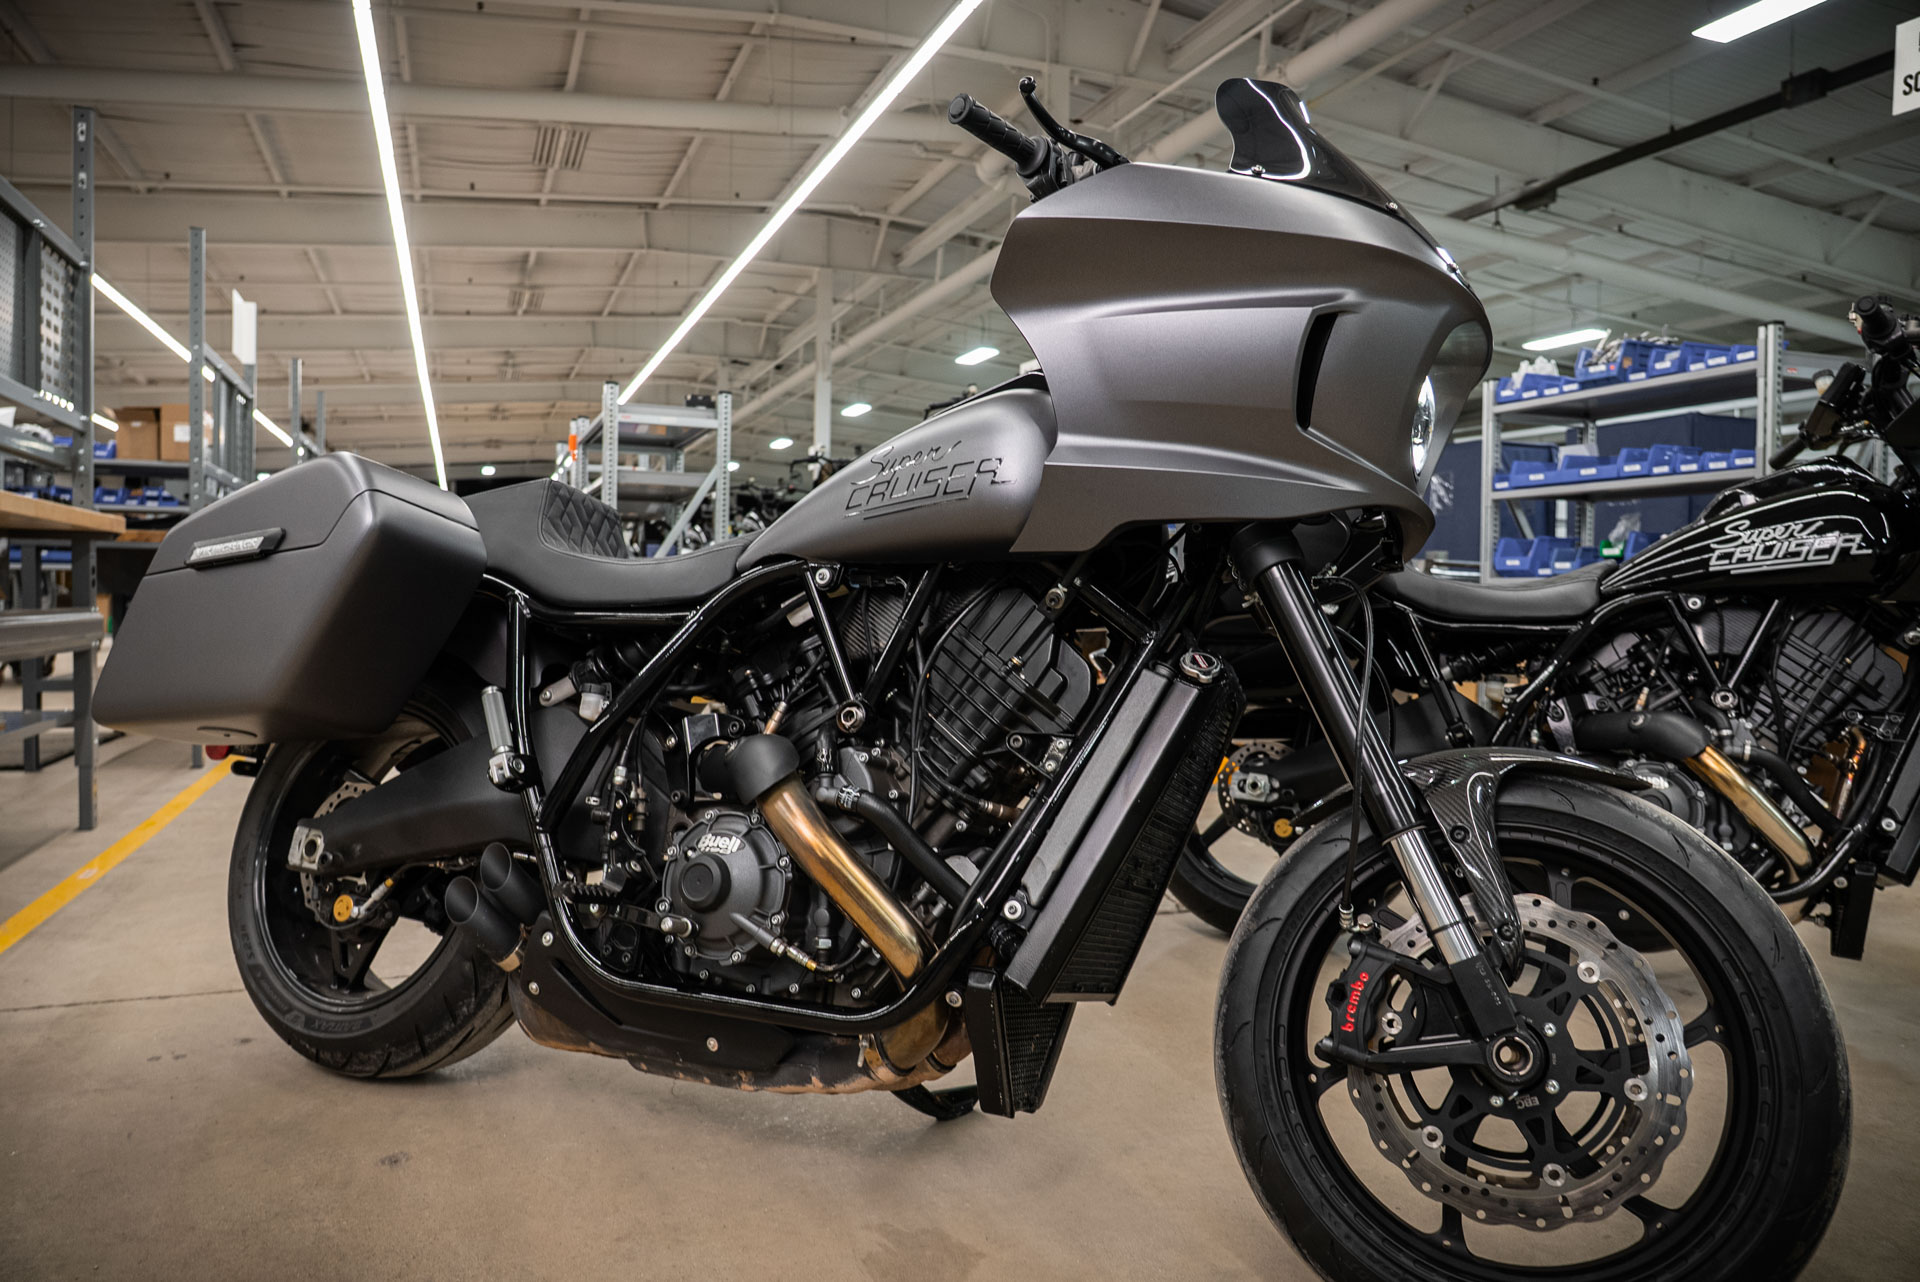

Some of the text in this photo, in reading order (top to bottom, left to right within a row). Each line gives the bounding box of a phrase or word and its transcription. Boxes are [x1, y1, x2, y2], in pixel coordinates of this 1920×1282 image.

[851, 440, 962, 485] Super
[845, 457, 1017, 512] CRUISER
[1709, 531, 1873, 567] CRUISER
[1710, 519, 1824, 549] Super
[698, 833, 741, 853] Buell
[1340, 971, 1369, 1032] brembo
[1515, 1096, 1540, 1110] EBC
